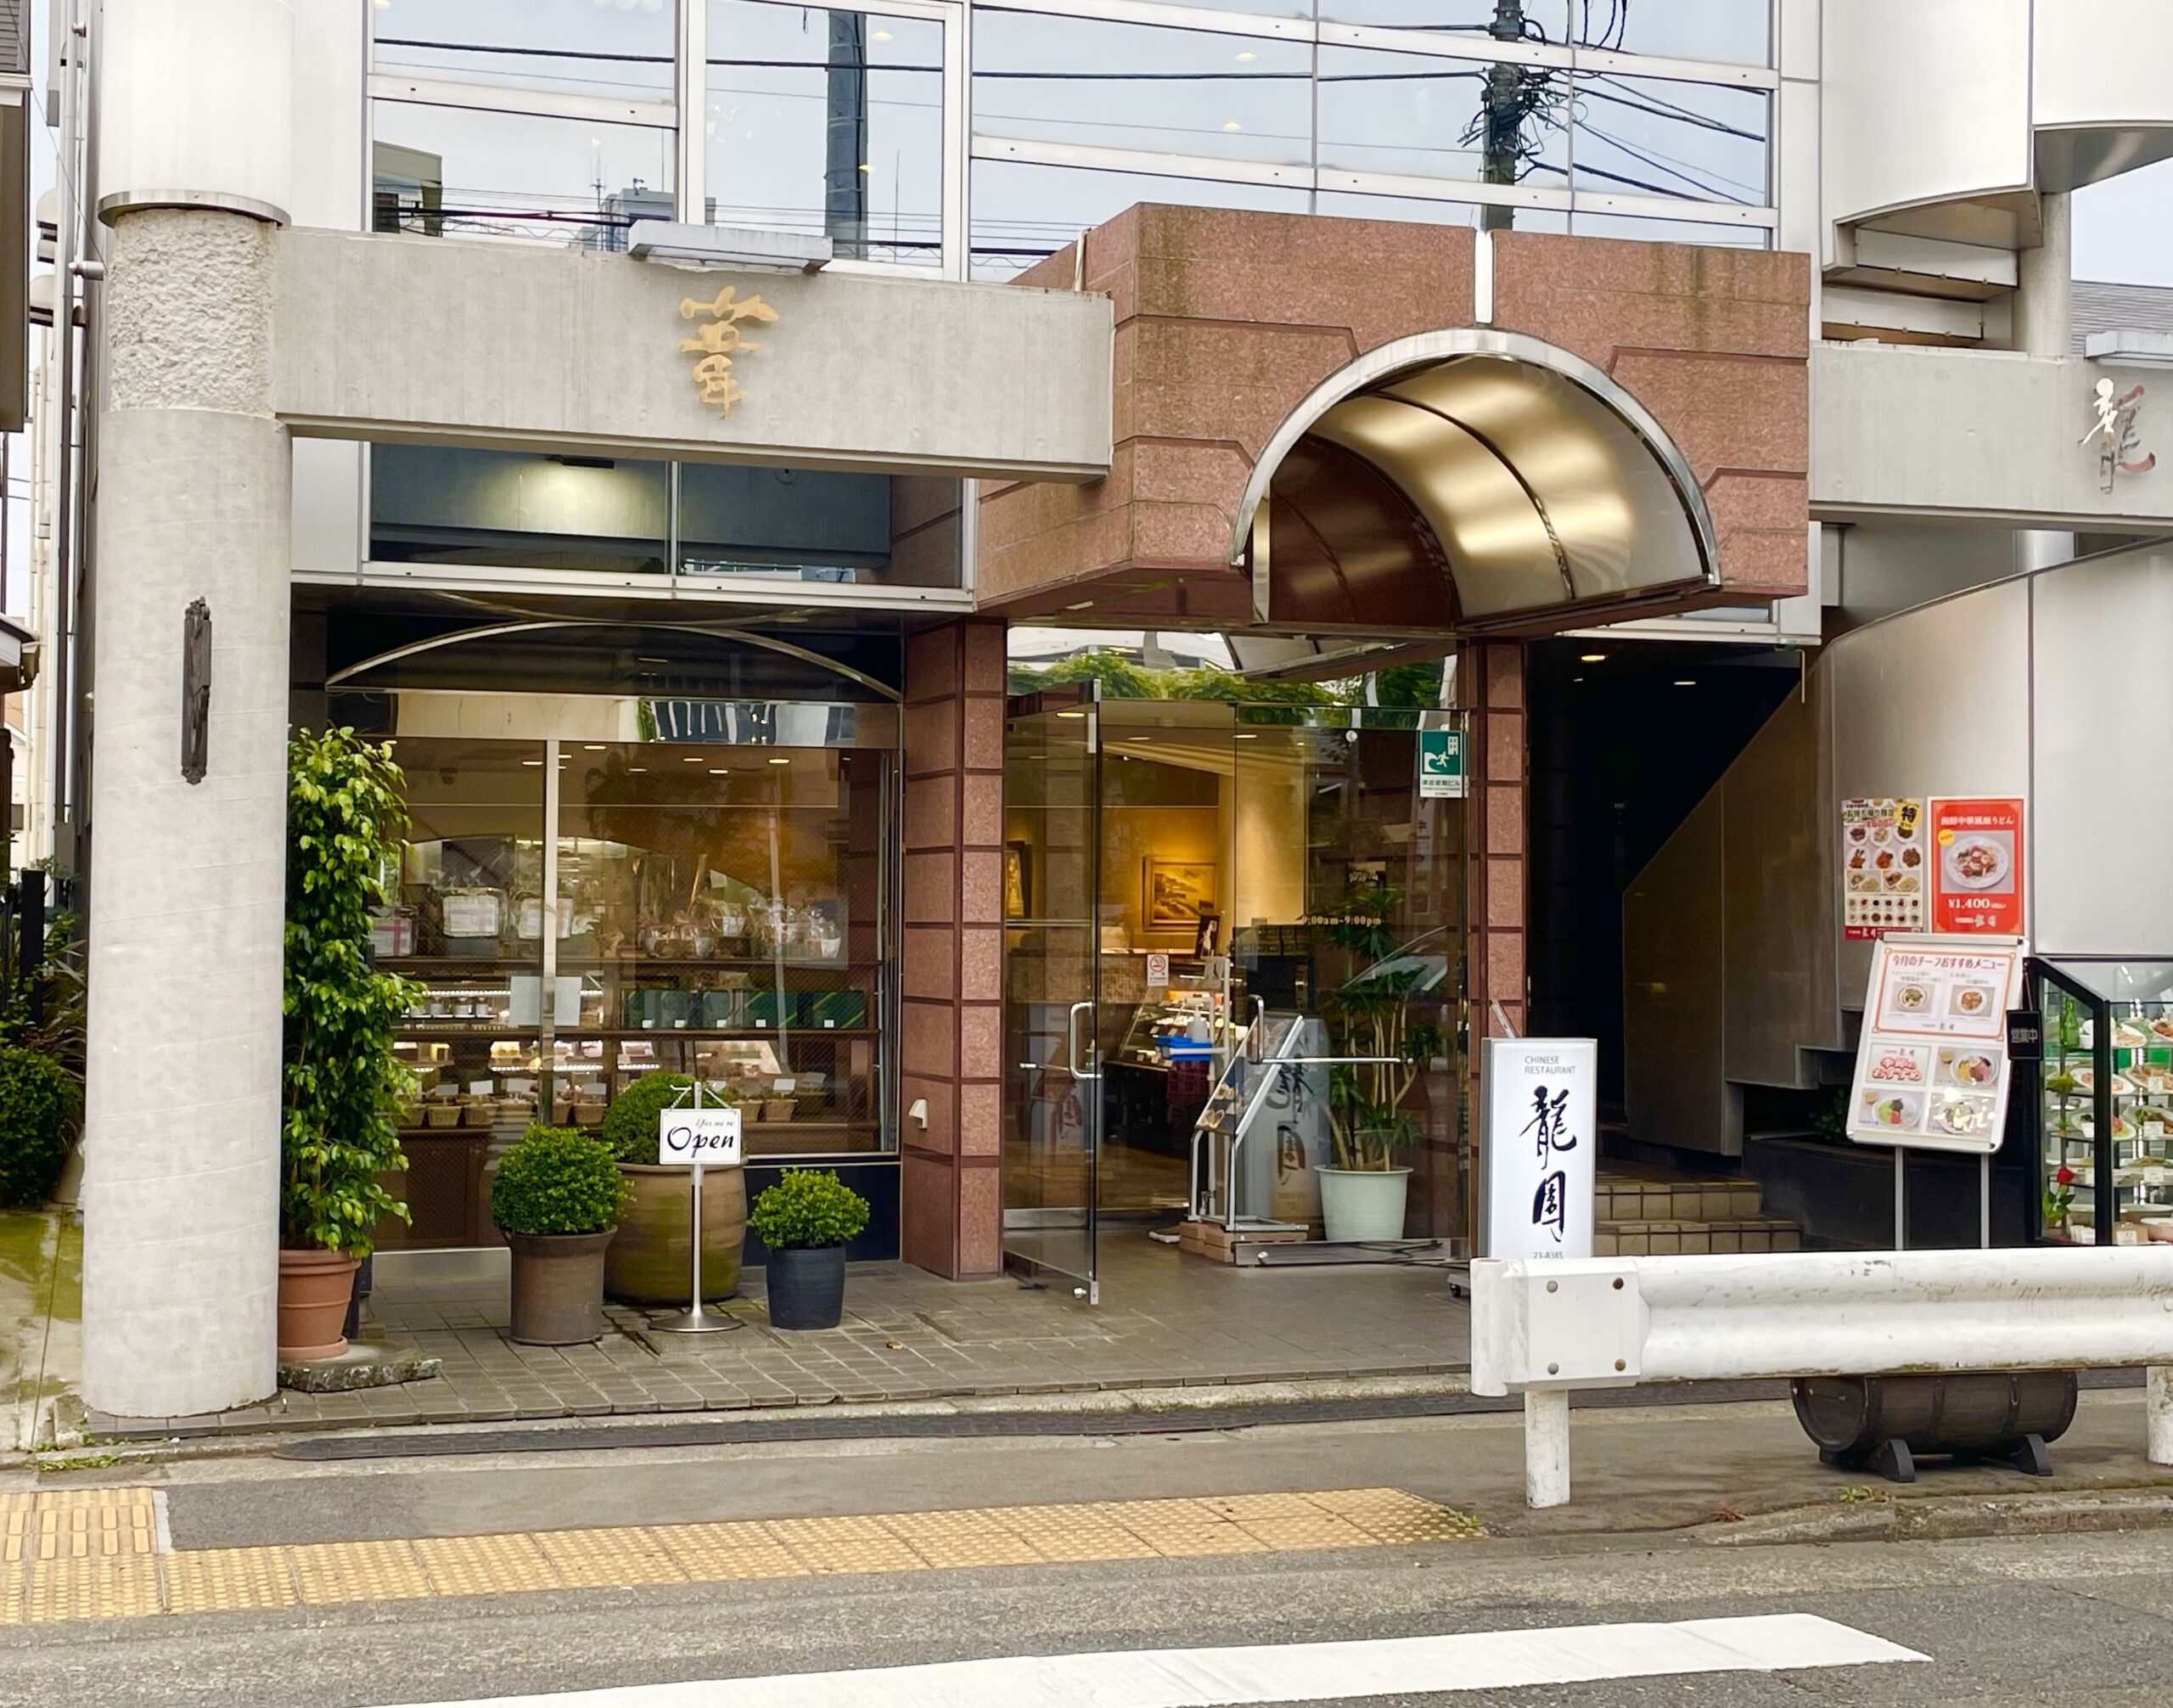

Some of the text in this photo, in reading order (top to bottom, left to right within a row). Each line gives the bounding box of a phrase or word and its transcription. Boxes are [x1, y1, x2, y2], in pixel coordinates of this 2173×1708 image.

[1947, 897, 1991, 909] ¥1,400
[1892, 954, 2006, 969] 今月のチーフおすすめメニュー
[1524, 1056, 1559, 1065] CHINESE
[1524, 1065, 1575, 1074] RESTAURANT
[667, 1126, 734, 1158] Open
[1519, 1086, 1577, 1242] 龍園
